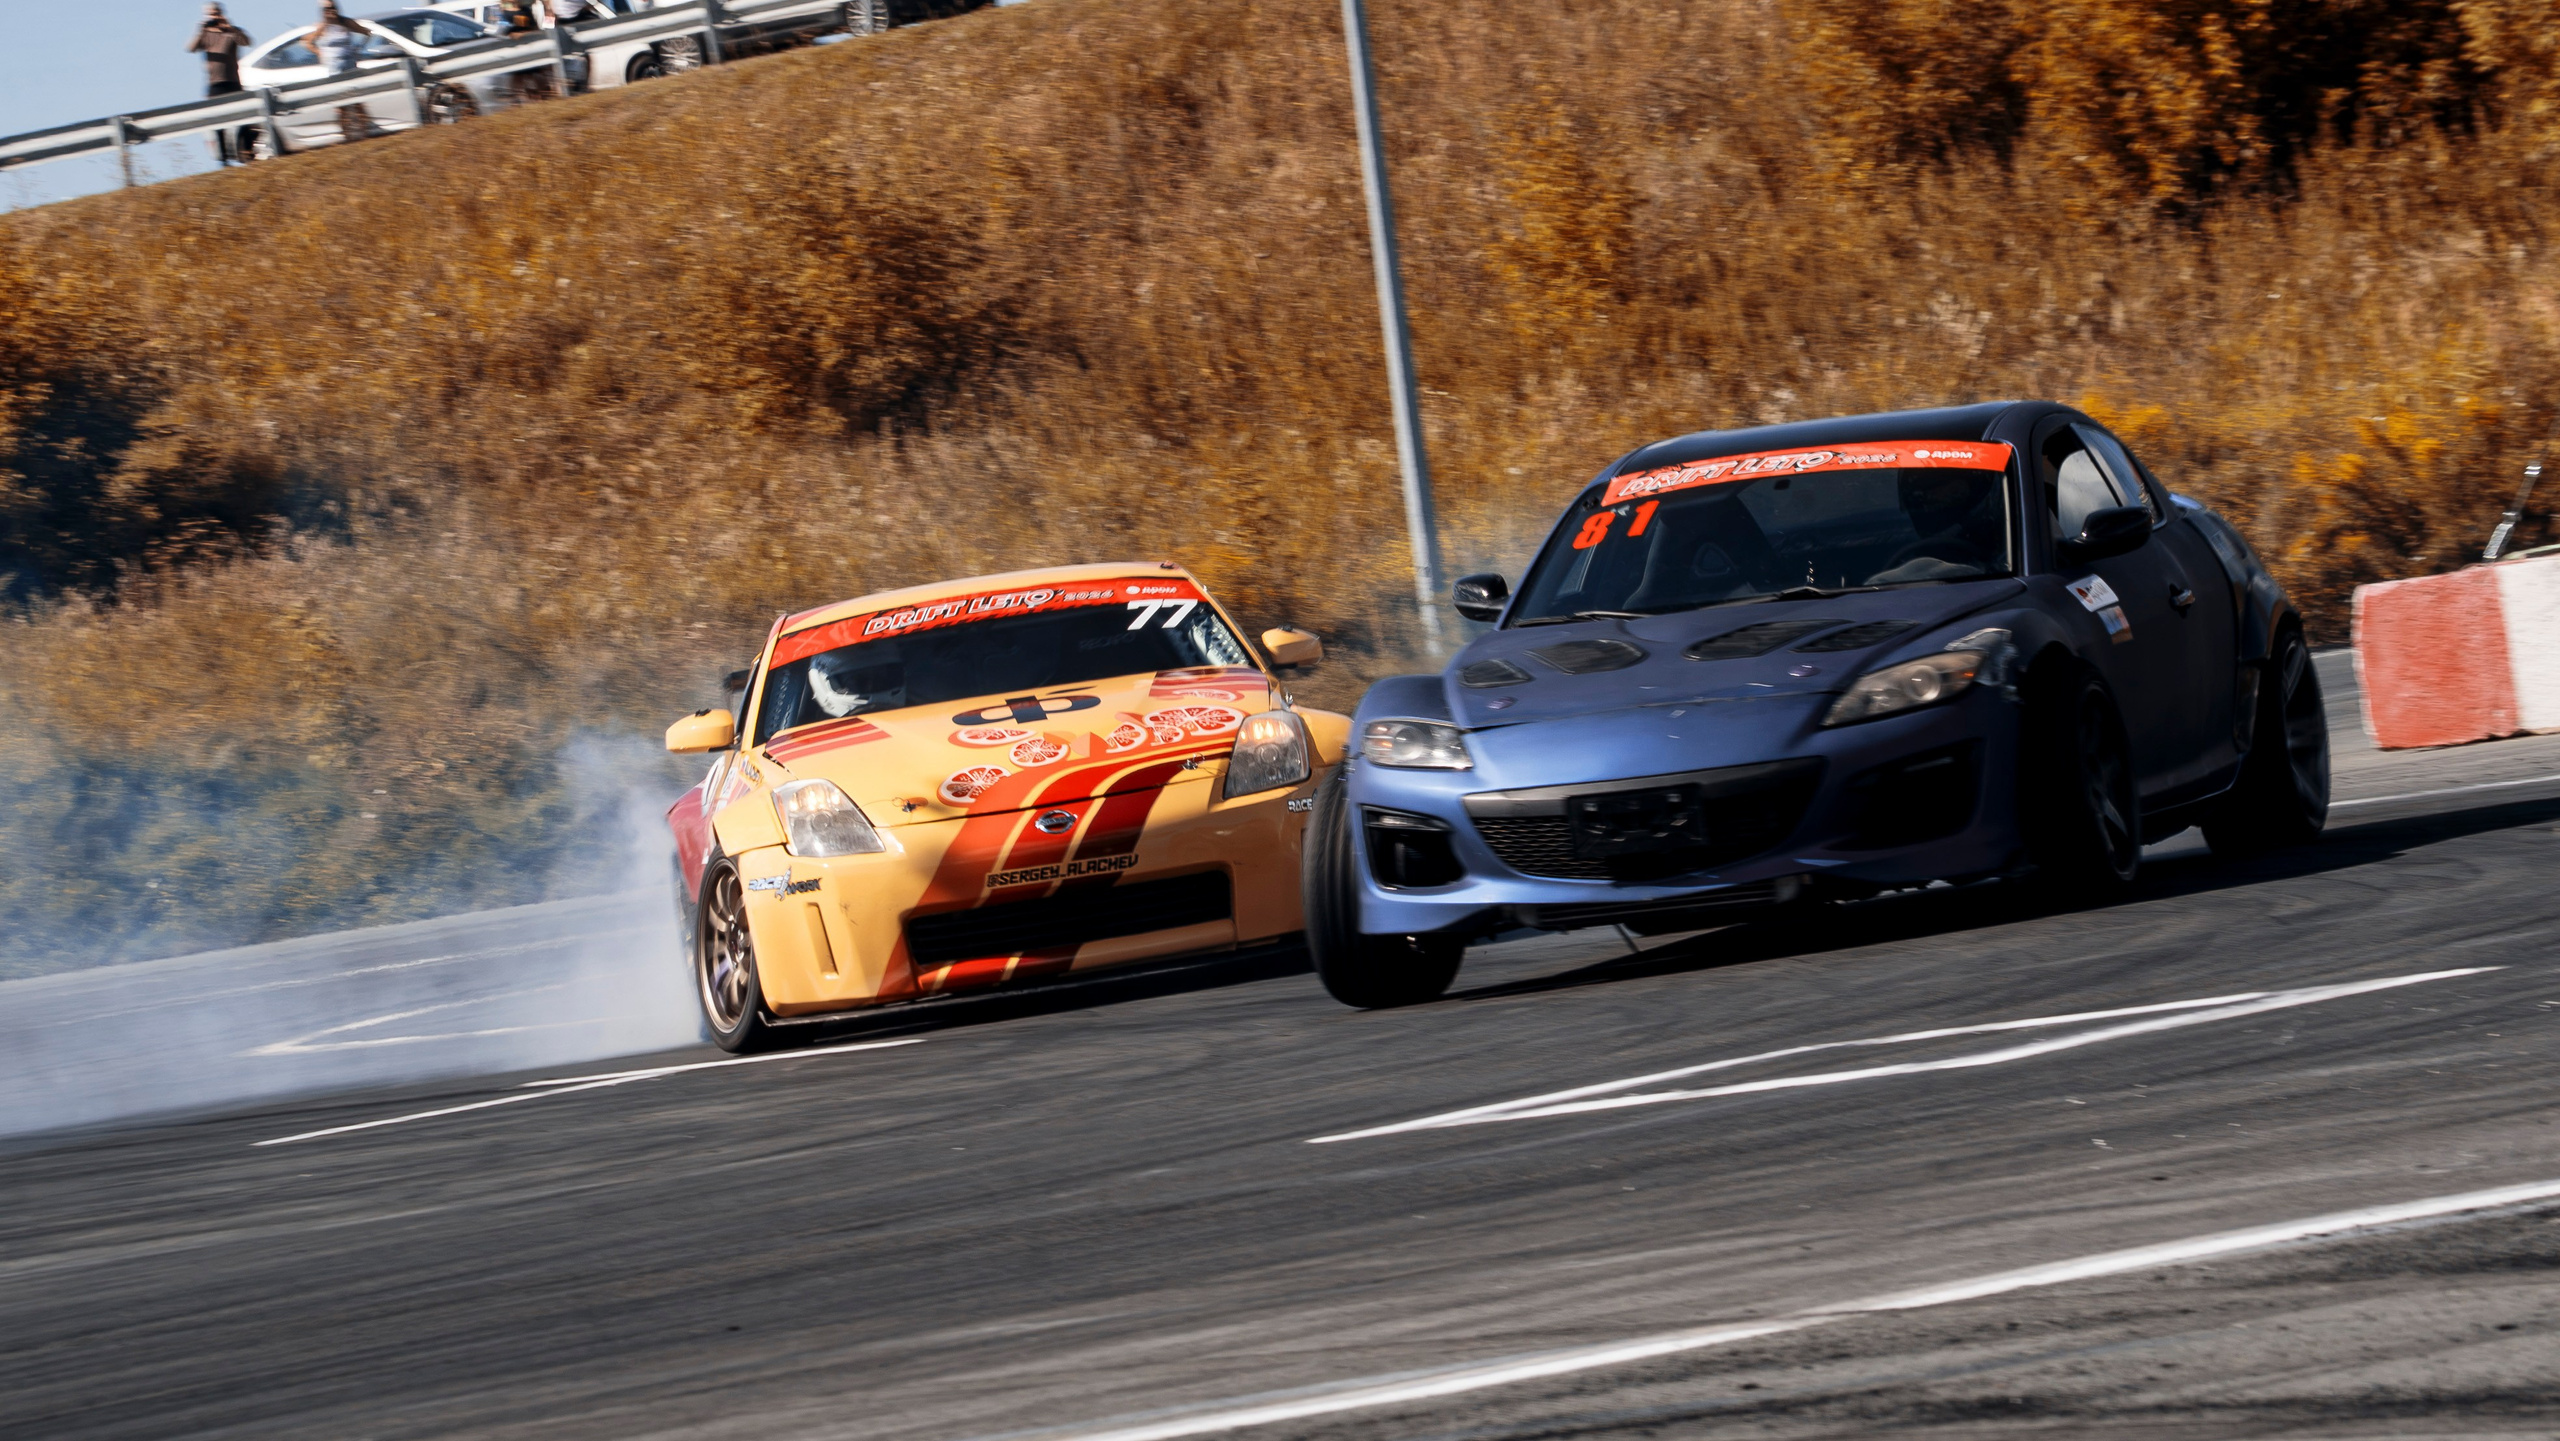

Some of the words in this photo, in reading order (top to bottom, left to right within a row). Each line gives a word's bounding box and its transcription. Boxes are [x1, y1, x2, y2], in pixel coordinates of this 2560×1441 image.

[1618, 460, 1738, 497] DRIFT
[1732, 451, 1835, 475] LETO
[863, 600, 969, 636] DRIFT
[968, 588, 1056, 614] LETO
[1126, 598, 1199, 631] 77
[1287, 797, 1313, 812] RACE
[747, 875, 784, 892] RACE
[785, 876, 822, 896] WORK
